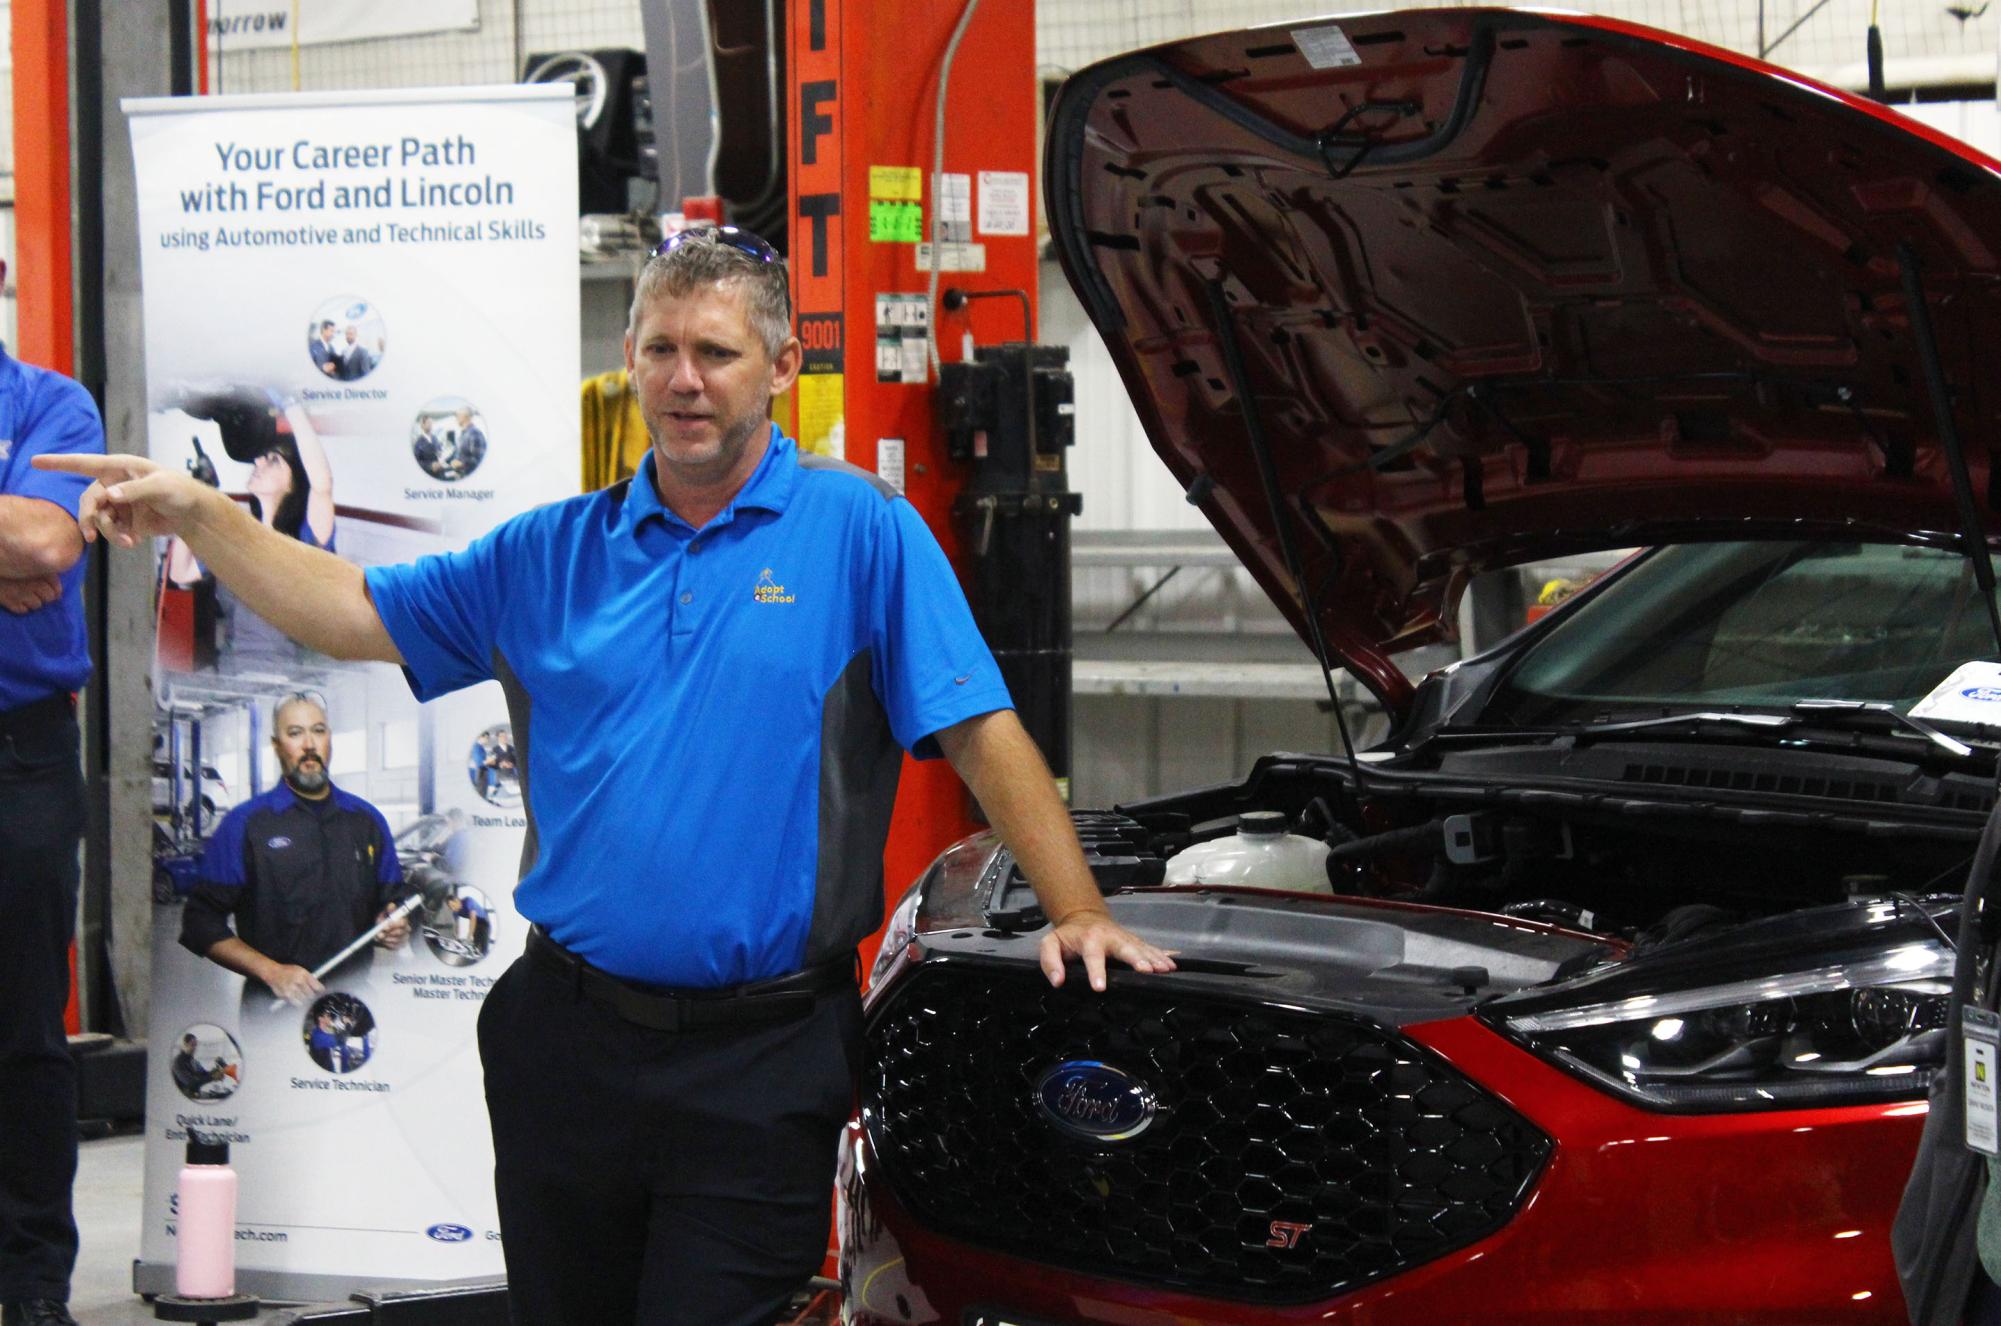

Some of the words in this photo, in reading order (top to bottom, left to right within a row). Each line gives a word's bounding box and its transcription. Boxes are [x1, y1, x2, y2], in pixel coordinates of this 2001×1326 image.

[215, 142, 285, 172] Your
[292, 140, 393, 169] Career
[401, 136, 475, 166] Path
[180, 181, 248, 212] with
[257, 179, 325, 210] Ford
[333, 177, 392, 209] and
[401, 175, 514, 207] Lincoln
[160, 228, 210, 252] using
[215, 226, 338, 247] Automotive
[342, 223, 382, 244] and
[386, 220, 483, 243] Technical
[488, 220, 546, 241] Skills
[802, 321, 841, 350] 9001
[302, 388, 342, 400] Service
[344, 388, 388, 400] Director
[404, 488, 444, 500] Service
[446, 488, 494, 502] Manager
[755, 585, 784, 595] Adopt
[761, 593, 796, 603] School
[472, 815, 502, 827] Team
[505, 816, 526, 827] Lea
[392, 973, 428, 985] Senior
[430, 974, 467, 986] Master
[470, 975, 498, 989] Tech
[413, 987, 451, 999] Master
[290, 1077, 330, 1090] Service
[332, 1078, 390, 1092] Technician
[1058, 1075, 1122, 1123] Ford
[176, 1114, 205, 1127] Quick
[206, 1115, 238, 1127] Lane/
[166, 1129, 190, 1141] Entr
[1266, 1220, 1313, 1248] ST
